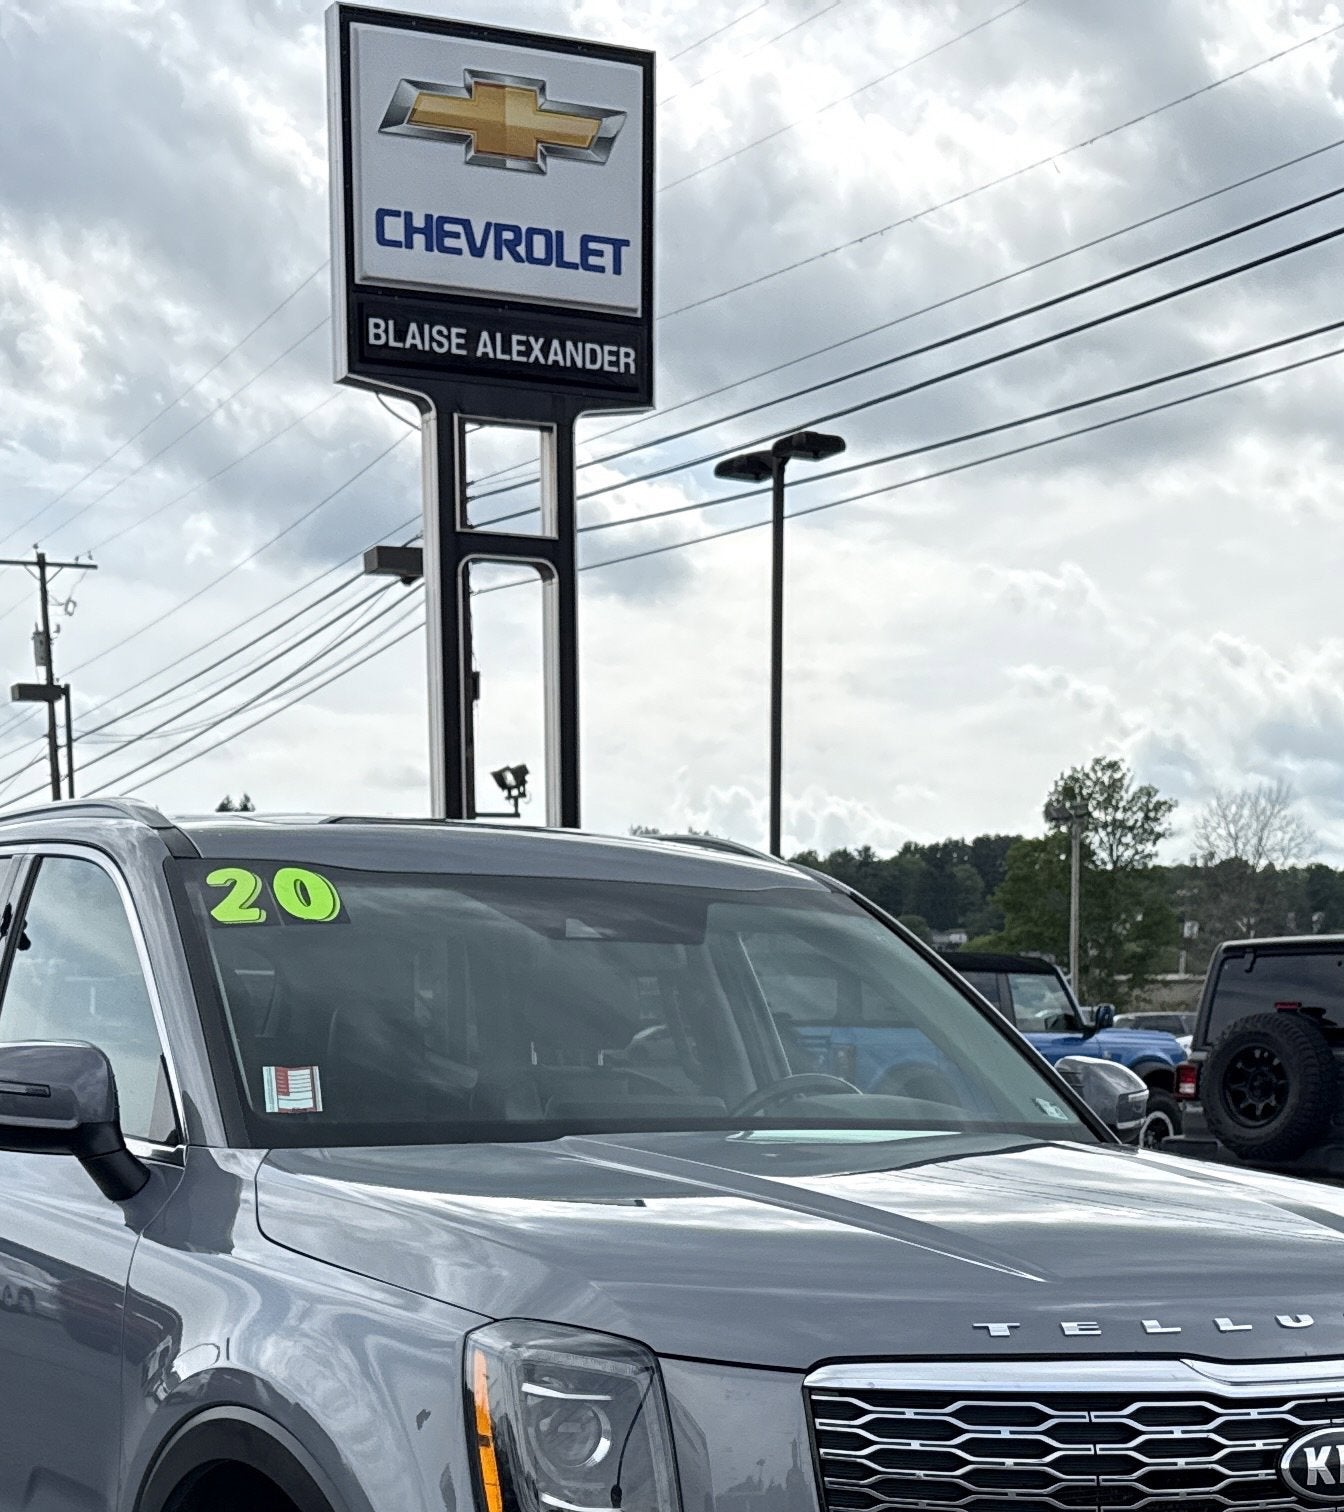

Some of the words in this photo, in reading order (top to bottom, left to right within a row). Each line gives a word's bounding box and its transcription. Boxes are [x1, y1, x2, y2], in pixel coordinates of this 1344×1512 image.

[375, 207, 631, 276] CHEVROLET
[368, 317, 467, 356] BLAISE
[476, 331, 636, 375] ALEXANDER
[206, 868, 340, 923] 20
